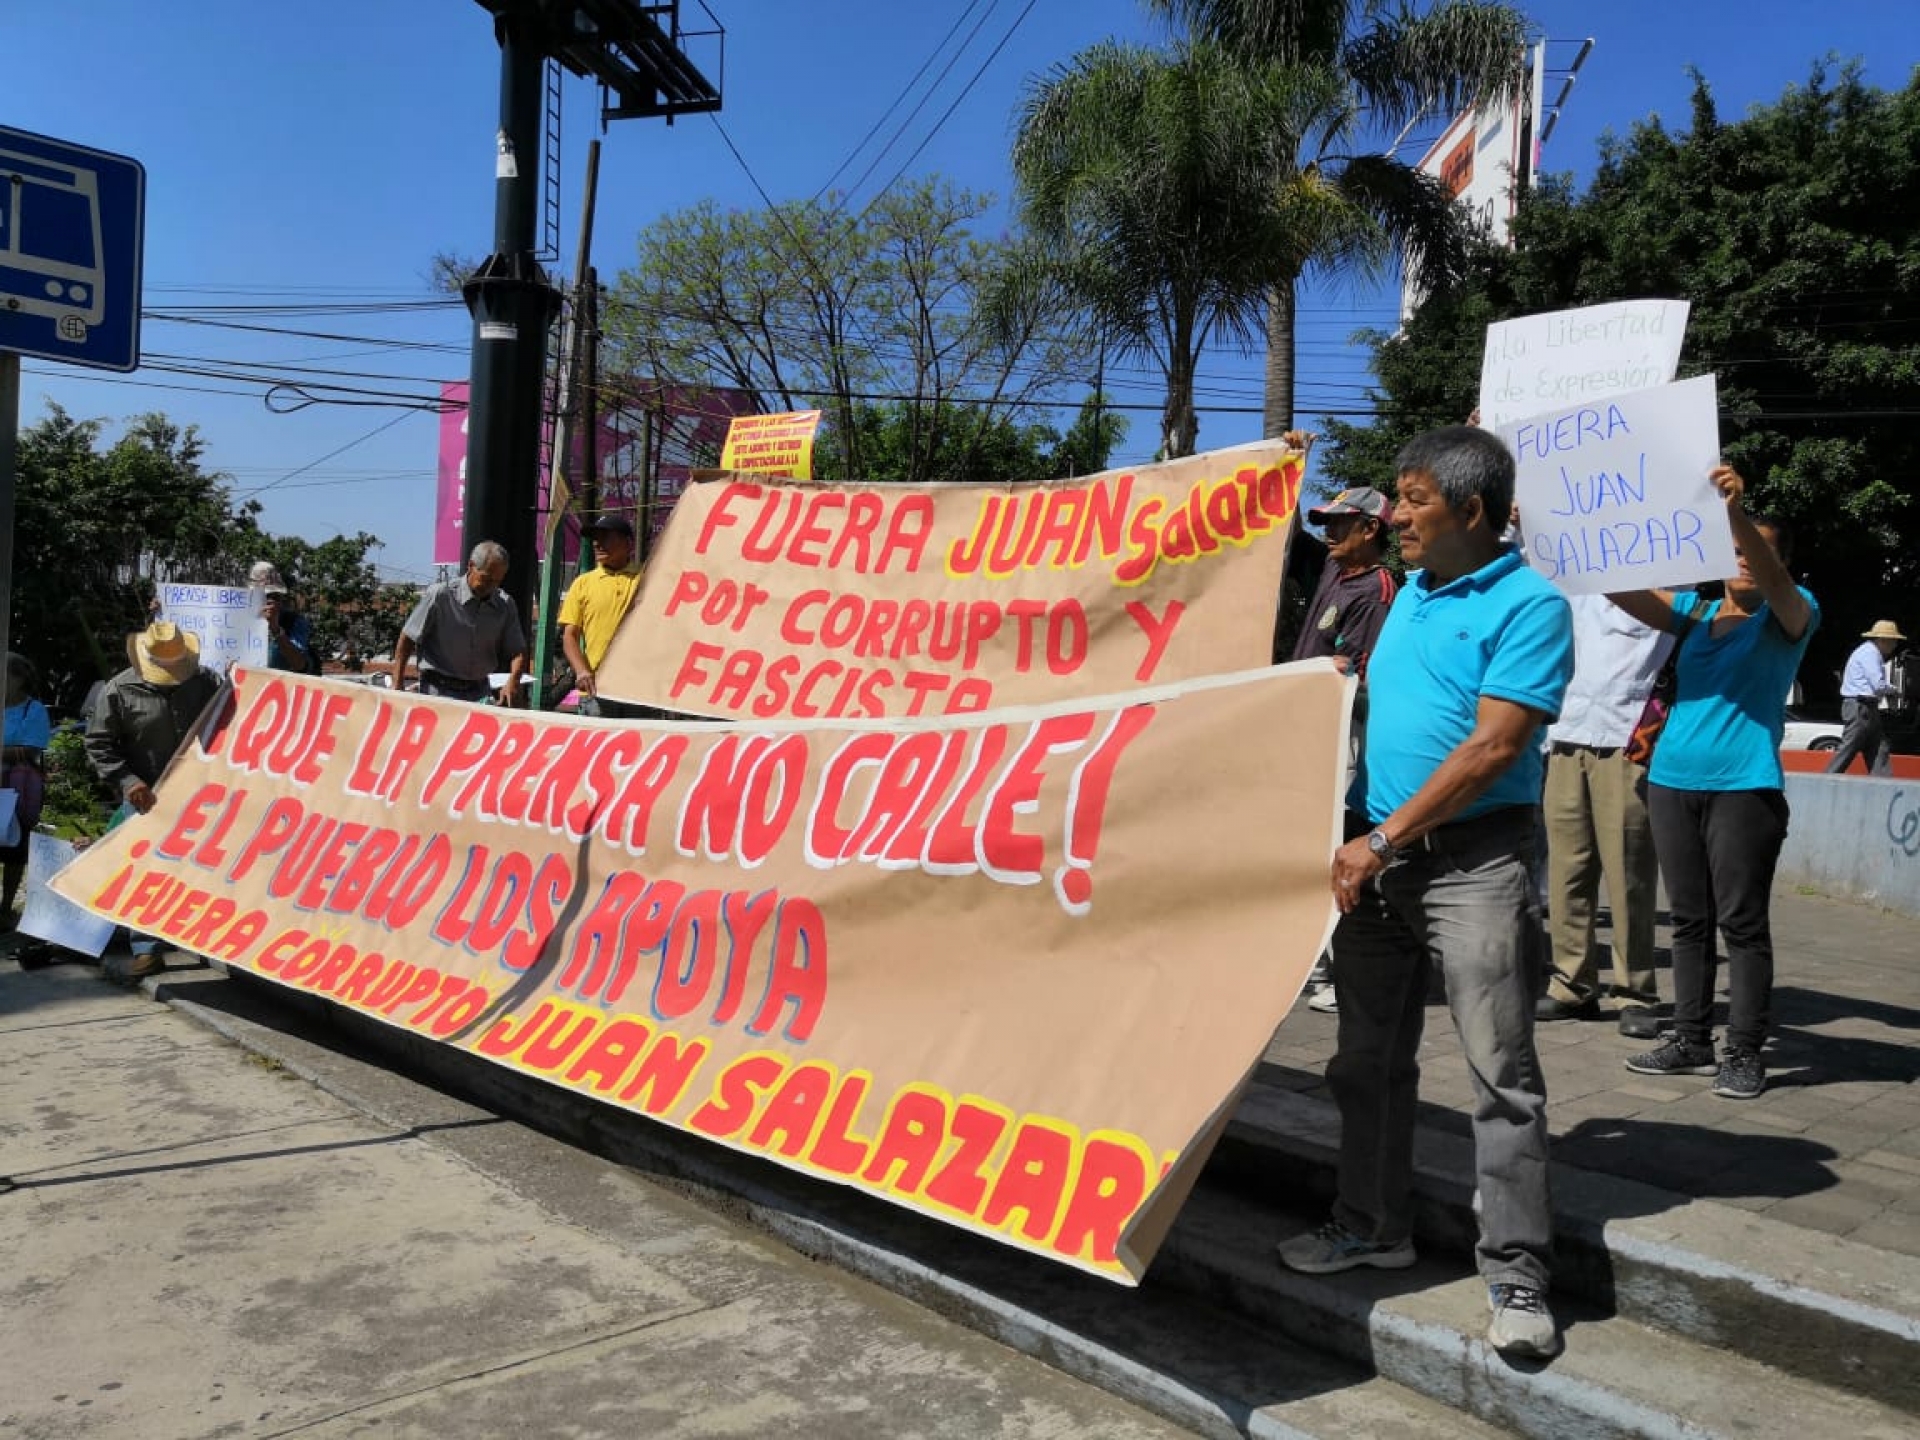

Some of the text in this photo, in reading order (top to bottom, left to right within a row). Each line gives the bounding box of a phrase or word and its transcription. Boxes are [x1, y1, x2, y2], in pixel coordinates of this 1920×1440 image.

[1546, 302, 1667, 349] Libertad
[1494, 354, 1663, 402] de Expresión
[1516, 403, 1630, 464] FUERA
[695, 455, 1306, 587] FUERA JUAN Salazar
[1551, 452, 1646, 516] JUAN
[1534, 510, 1705, 581] SALAZAR
[164, 586, 209, 604] PRENSA
[780, 587, 1089, 676] CORRUPTO
[1124, 599, 1185, 683] Y
[668, 641, 993, 718] FASCISTA
[344, 696, 439, 805] LA
[420, 709, 690, 857] PRENSA
[676, 732, 809, 869] NO
[805, 704, 1157, 918] CALLE!
[154, 781, 829, 1045] EL PUEBLO LOS APOYA
[91, 838, 1180, 1270] ¡FUERA CORRUPTO JUAN SALAZAR
